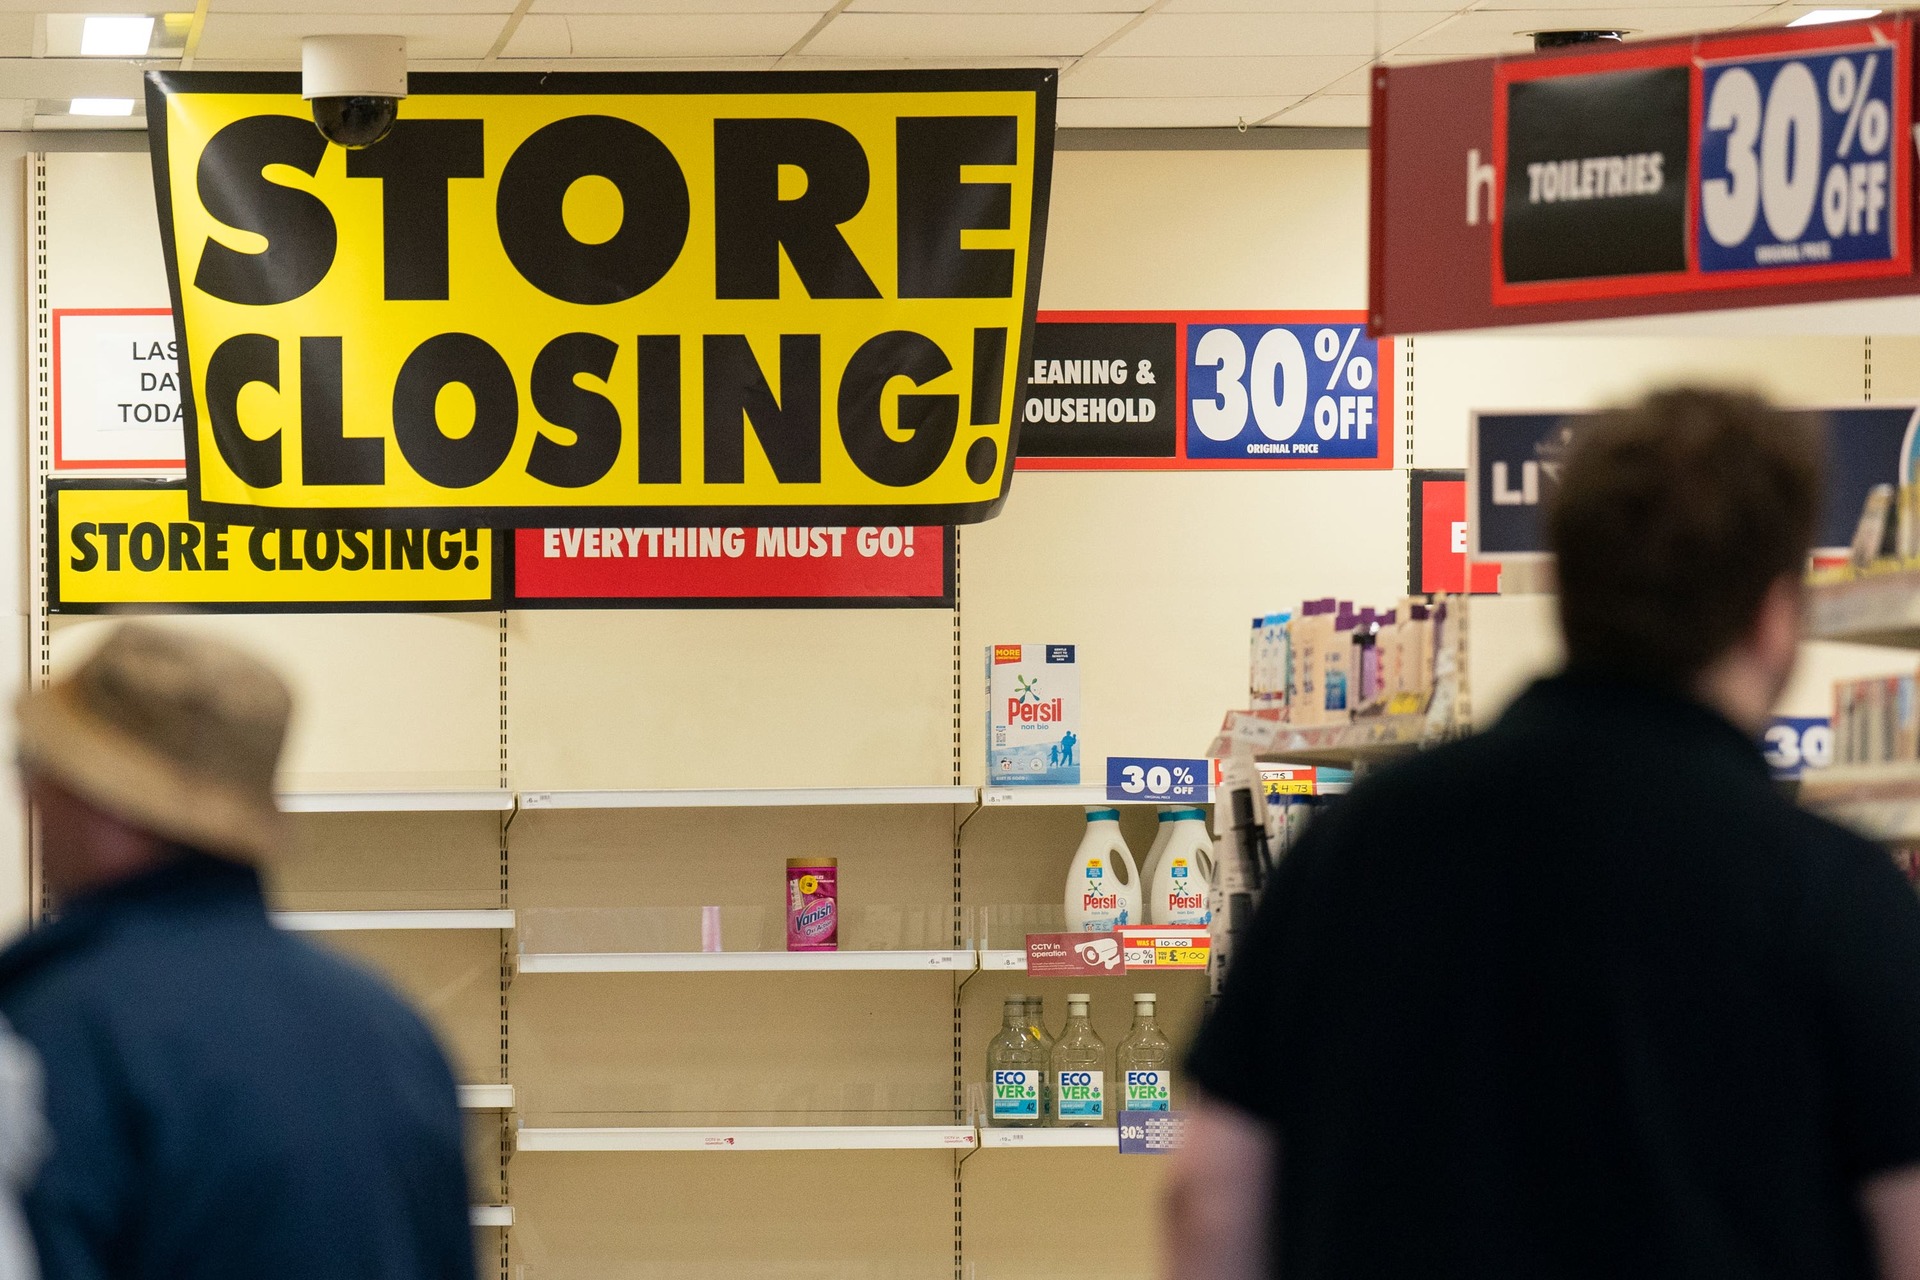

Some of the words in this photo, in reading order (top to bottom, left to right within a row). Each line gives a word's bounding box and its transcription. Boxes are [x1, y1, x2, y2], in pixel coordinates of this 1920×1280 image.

[1527, 151, 1664, 203] TOILETRIES
[194, 114, 1017, 305] STORE
[1822, 161, 1888, 239] OFF
[133, 341, 178, 360] LAS
[141, 372, 180, 391] DA
[1027, 359, 1128, 385] EANING
[1135, 359, 1157, 385] &
[117, 403, 183, 423] TODA
[205, 327, 1008, 488] CLOSING!
[1021, 397, 1156, 423] OUSEHOLD
[1314, 395, 1373, 441] OFF
[1246, 443, 1291, 454] ORIGINAL
[1292, 443, 1319, 454] PRICE
[70, 521, 229, 572] STORE
[248, 525, 480, 572] CLOSING!
[543, 527, 745, 558] EVERYTHING
[755, 527, 847, 558] MUST
[856, 526, 915, 557] GO!
[1008, 698, 1062, 725] Persil
[1173, 786, 1194, 794] OFF
[1084, 894, 1116, 911] Persil
[1169, 894, 1202, 911] Persil
[796, 903, 832, 932] Vanish
[1031, 950, 1067, 958] operation
[996, 1072, 1026, 1084] ECO
[1062, 1073, 1091, 1086] ECO
[1128, 1072, 1158, 1085] ECO
[996, 1086, 1024, 1098] VER
[1062, 1086, 1090, 1099] VER
[1128, 1086, 1157, 1098] VER
